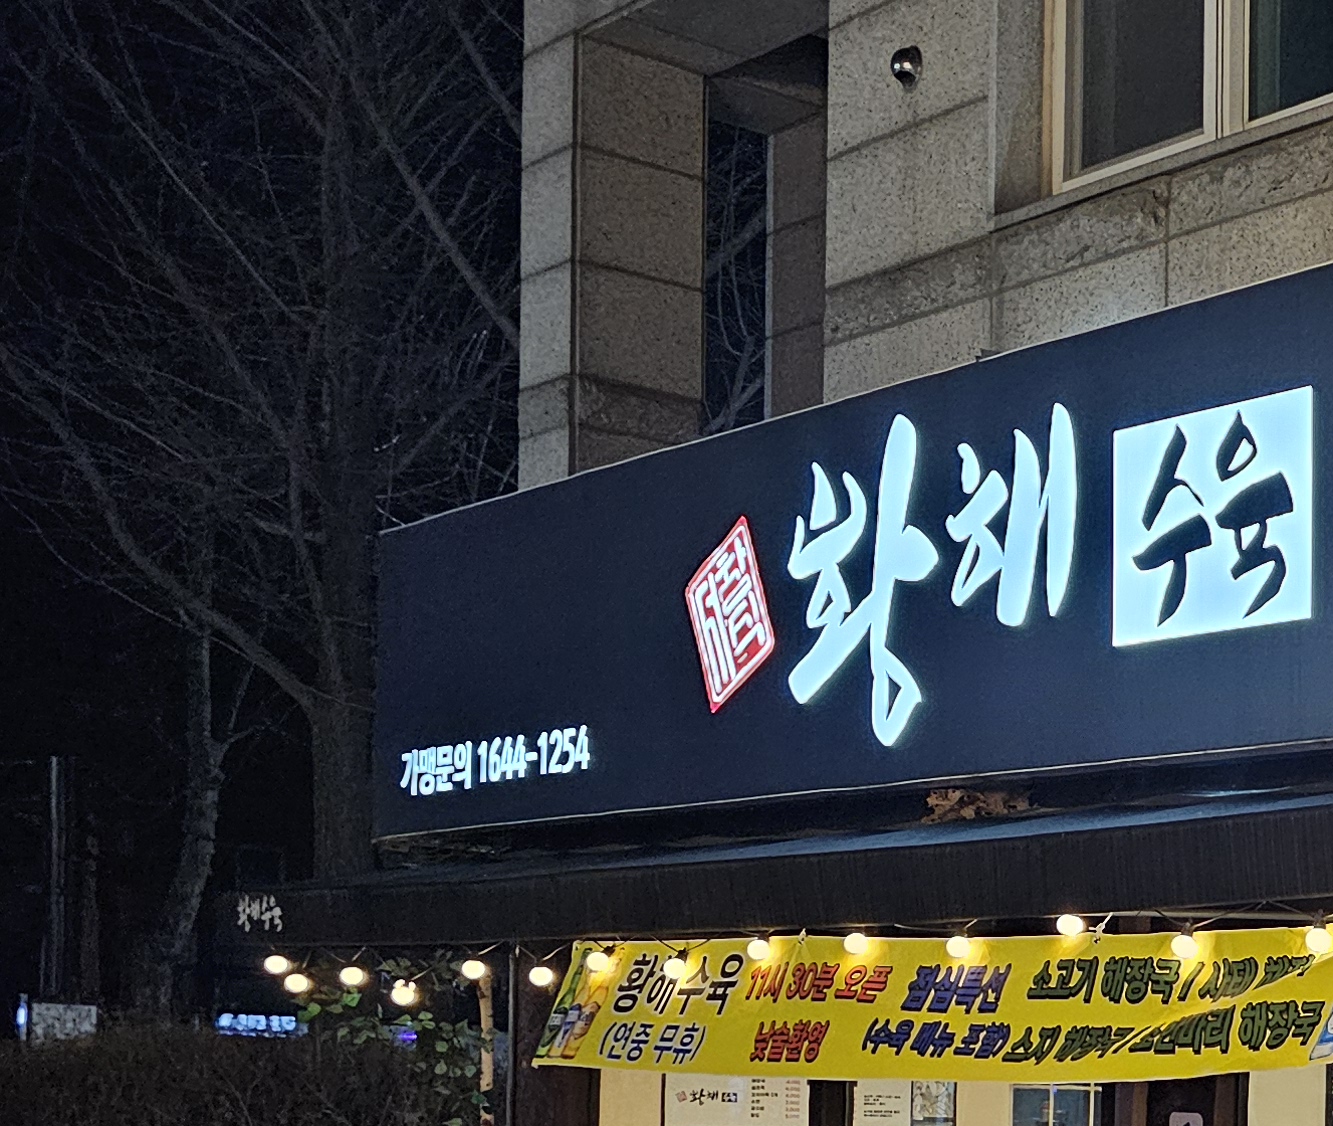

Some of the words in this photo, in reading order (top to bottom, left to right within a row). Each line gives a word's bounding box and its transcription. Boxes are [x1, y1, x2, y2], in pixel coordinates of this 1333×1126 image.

[788, 402, 1078, 747] 황해
[1130, 409, 1294, 628] 수육
[400, 740, 472, 796] 가맹문의
[477, 724, 590, 783] 1644-1254
[745, 961, 790, 1003] 11시
[786, 961, 840, 1002] 30분
[835, 964, 894, 1003] 오픈
[901, 963, 1013, 1014] 점심특선
[1027, 956, 1099, 1002] 소고기
[1101, 956, 1182, 1005] 해장국
[599, 1021, 654, 1061] (연중
[652, 1021, 708, 1064] 무휴)
[862, 1017, 915, 1055] (수육
[910, 1020, 956, 1058] 메뉴
[953, 1021, 1012, 1059] 포함)
[1002, 1024, 1062, 1065] 스지
[1239, 1000, 1325, 1051] 해장국
